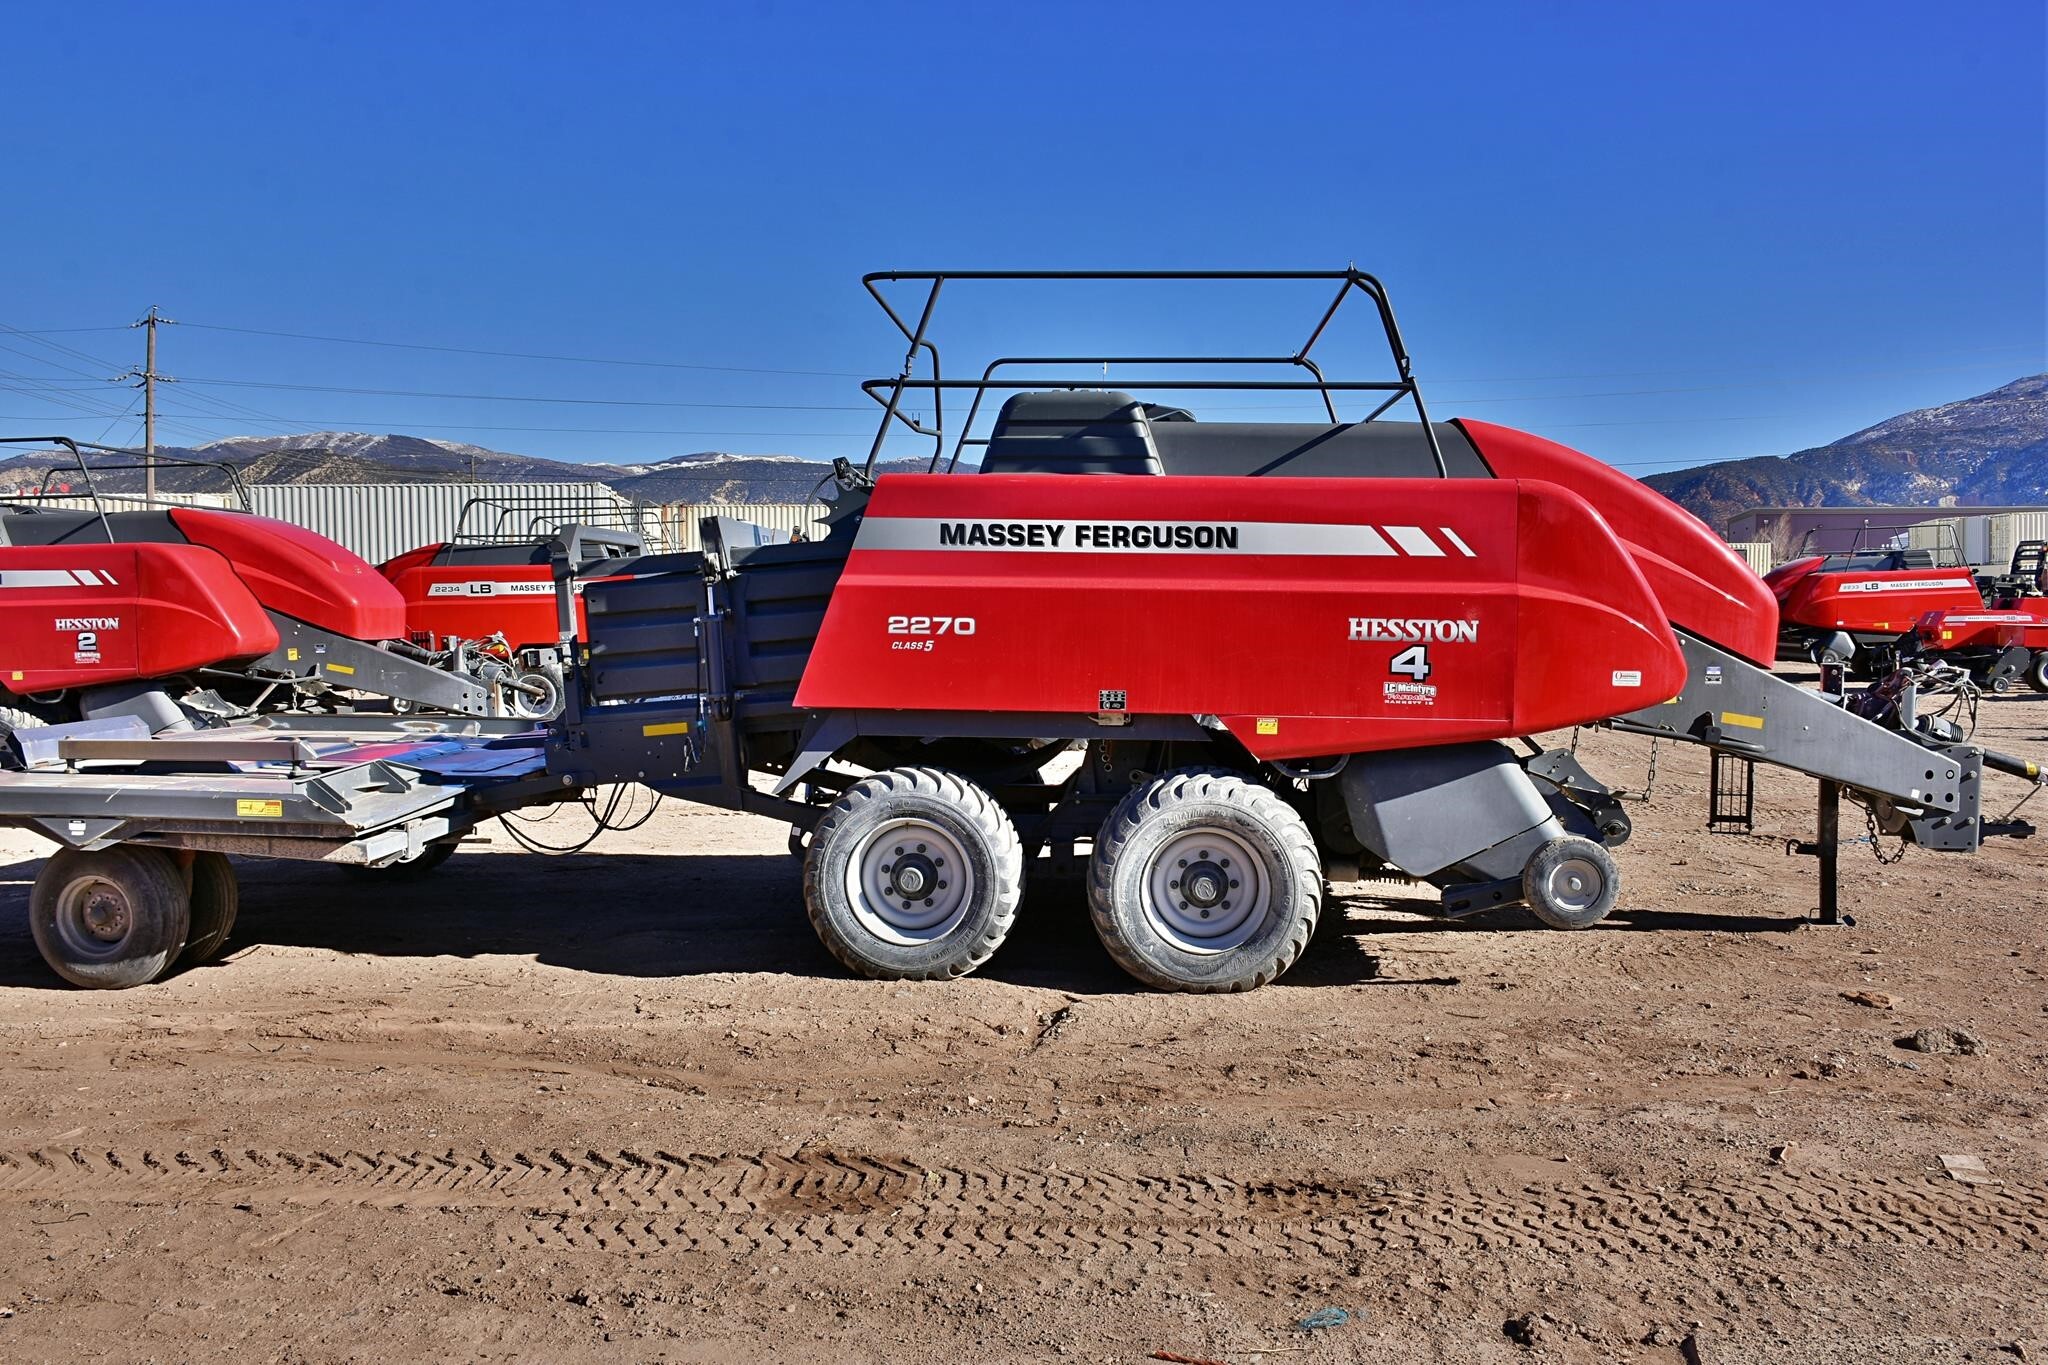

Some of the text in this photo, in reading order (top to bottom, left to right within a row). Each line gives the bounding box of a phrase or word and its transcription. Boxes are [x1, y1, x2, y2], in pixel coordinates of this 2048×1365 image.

[939, 522, 1238, 549] MASSEY FERGUSON
[470, 584, 492, 594] LB
[510, 584, 546, 592] MASSEY
[54, 617, 120, 631] HESSTON
[887, 616, 976, 635] 2270
[1347, 617, 1480, 643] HESSTON
[78, 632, 97, 651] 2
[891, 640, 935, 652] CLASS 5
[1390, 645, 1430, 681] 4
